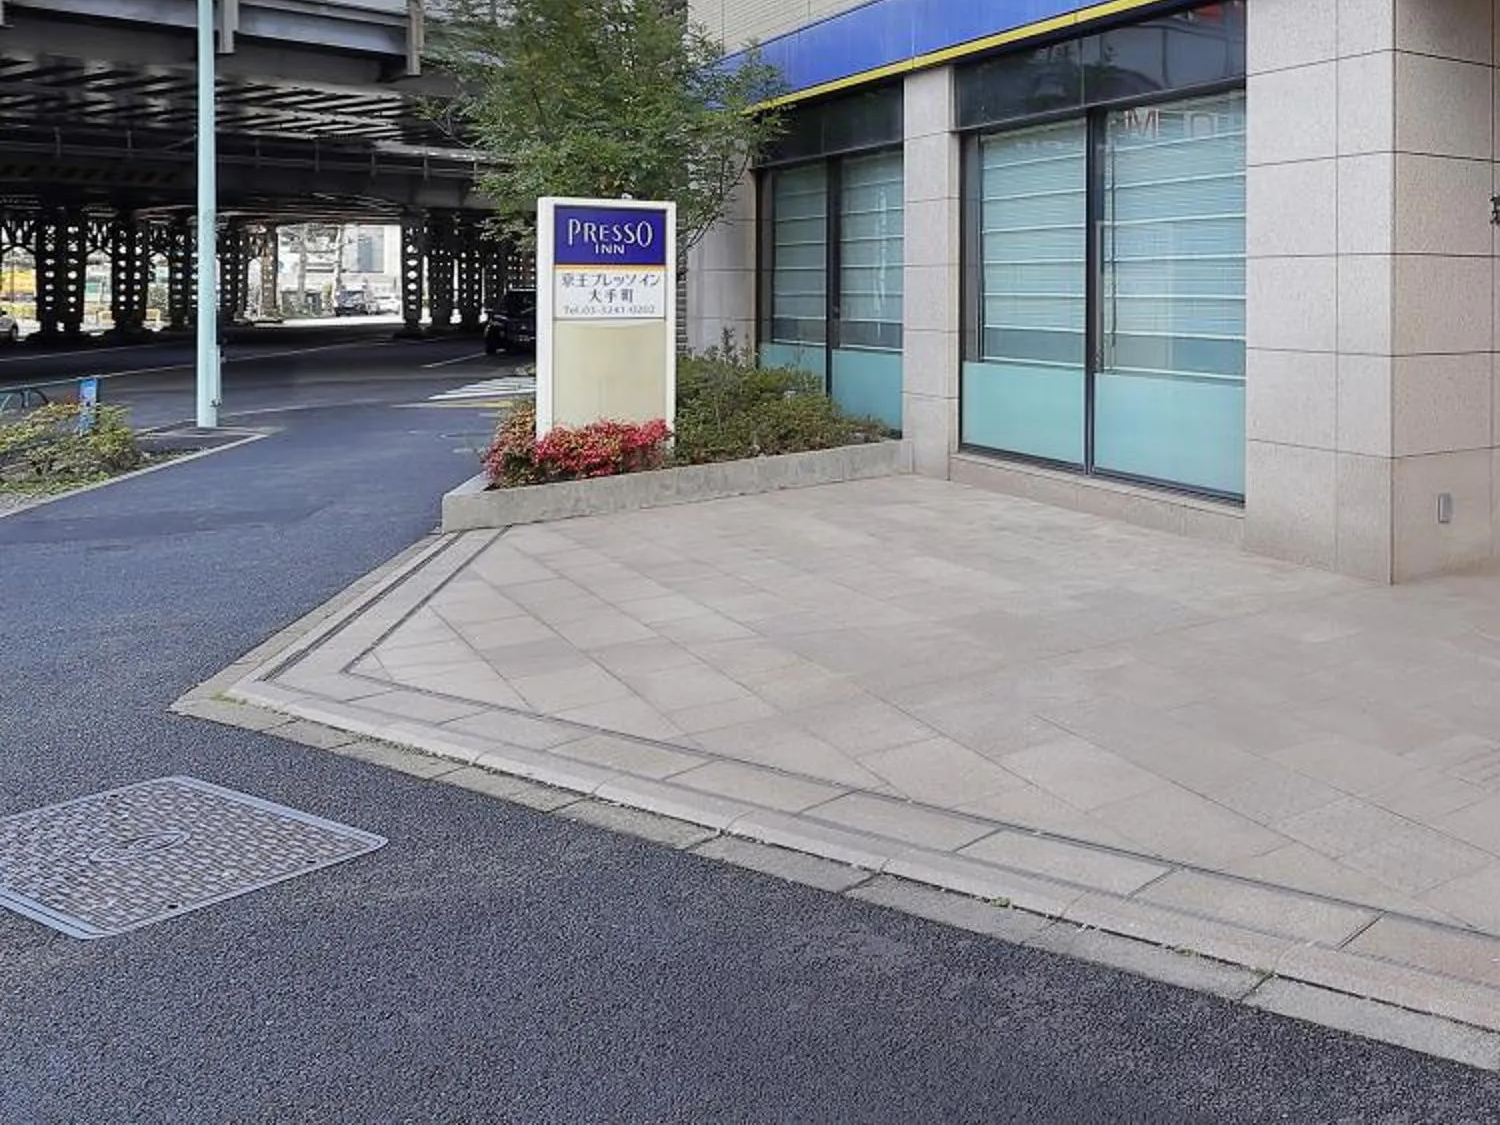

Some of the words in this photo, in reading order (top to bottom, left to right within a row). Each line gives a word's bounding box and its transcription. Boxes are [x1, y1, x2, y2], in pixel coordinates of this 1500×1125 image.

[568, 218, 653, 248] PRESSO
[595, 244, 625, 255] INN
[590, 288, 633, 304] 大手町
